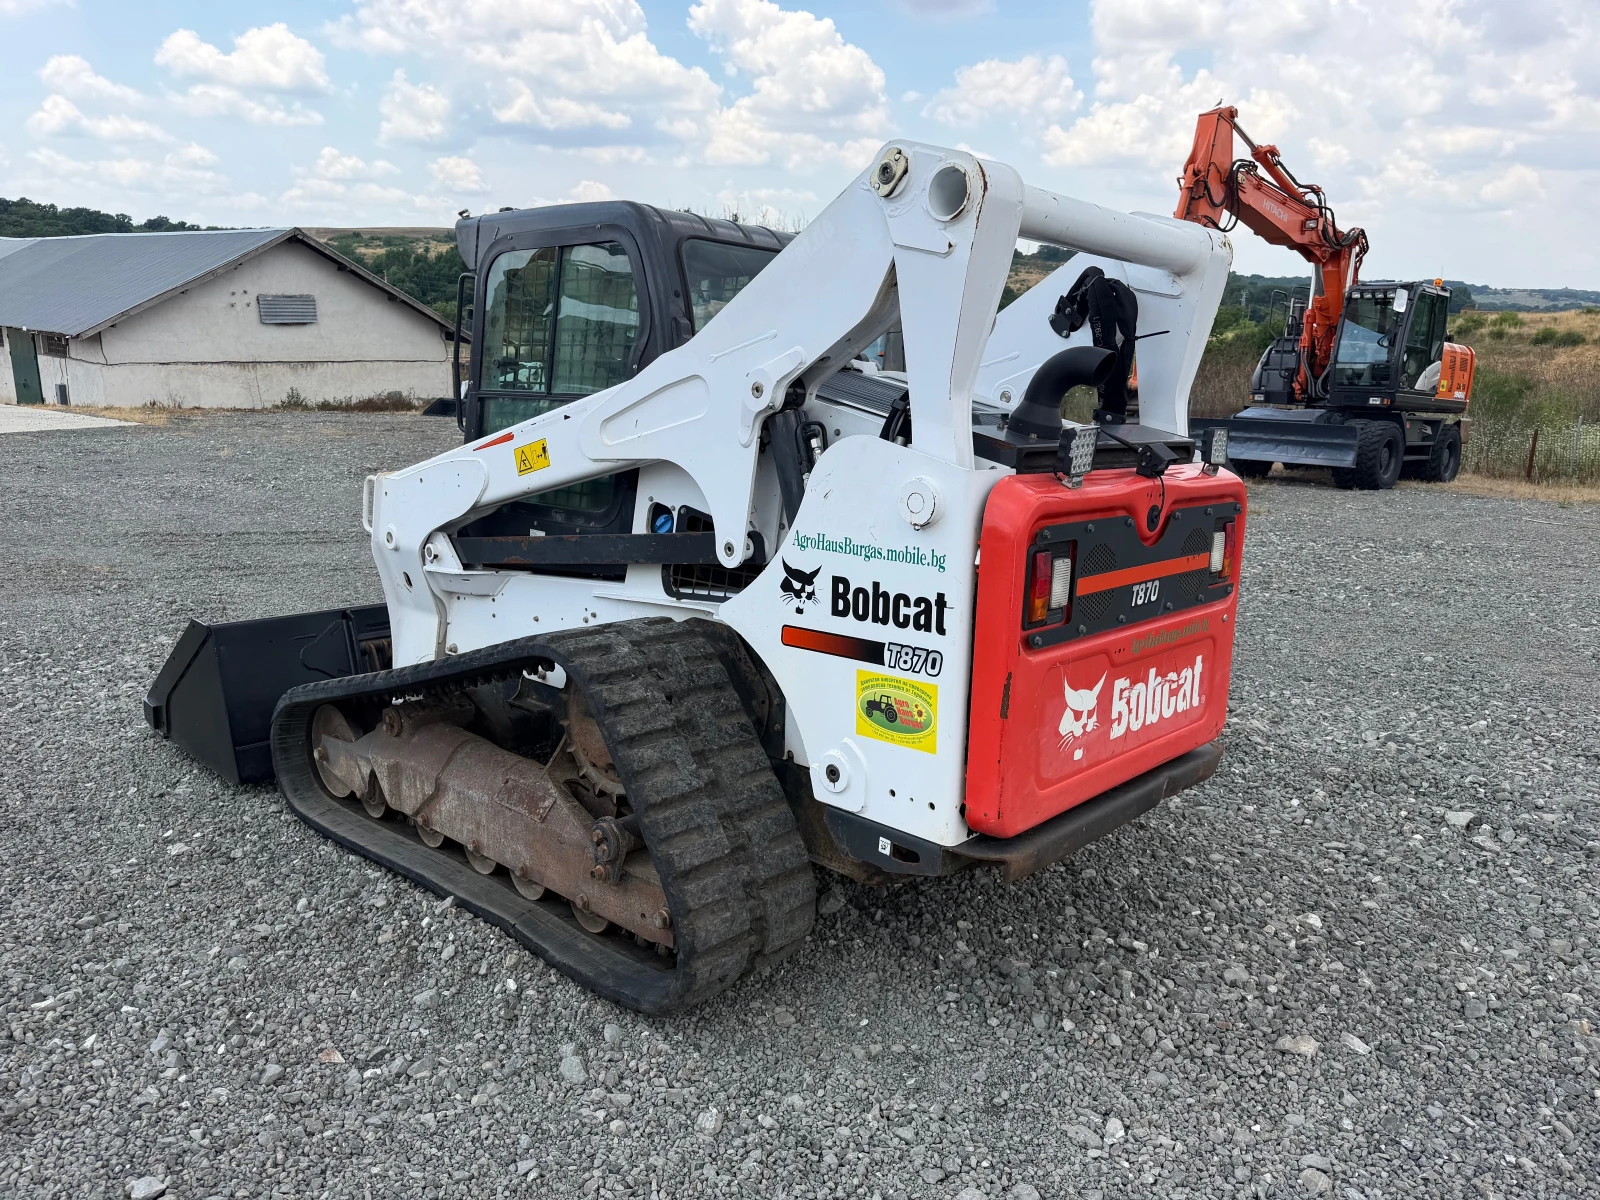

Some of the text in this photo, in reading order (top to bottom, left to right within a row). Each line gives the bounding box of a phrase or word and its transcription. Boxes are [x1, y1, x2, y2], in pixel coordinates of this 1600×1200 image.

[1262, 199, 1288, 222] HITACHI
[792, 529, 947, 573] AgroHausBurgas.mobile.bg
[831, 574, 947, 636] Bobcat
[1131, 580, 1160, 607] T870
[887, 642, 944, 677] T870
[1110, 655, 1203, 740] Bobcat
